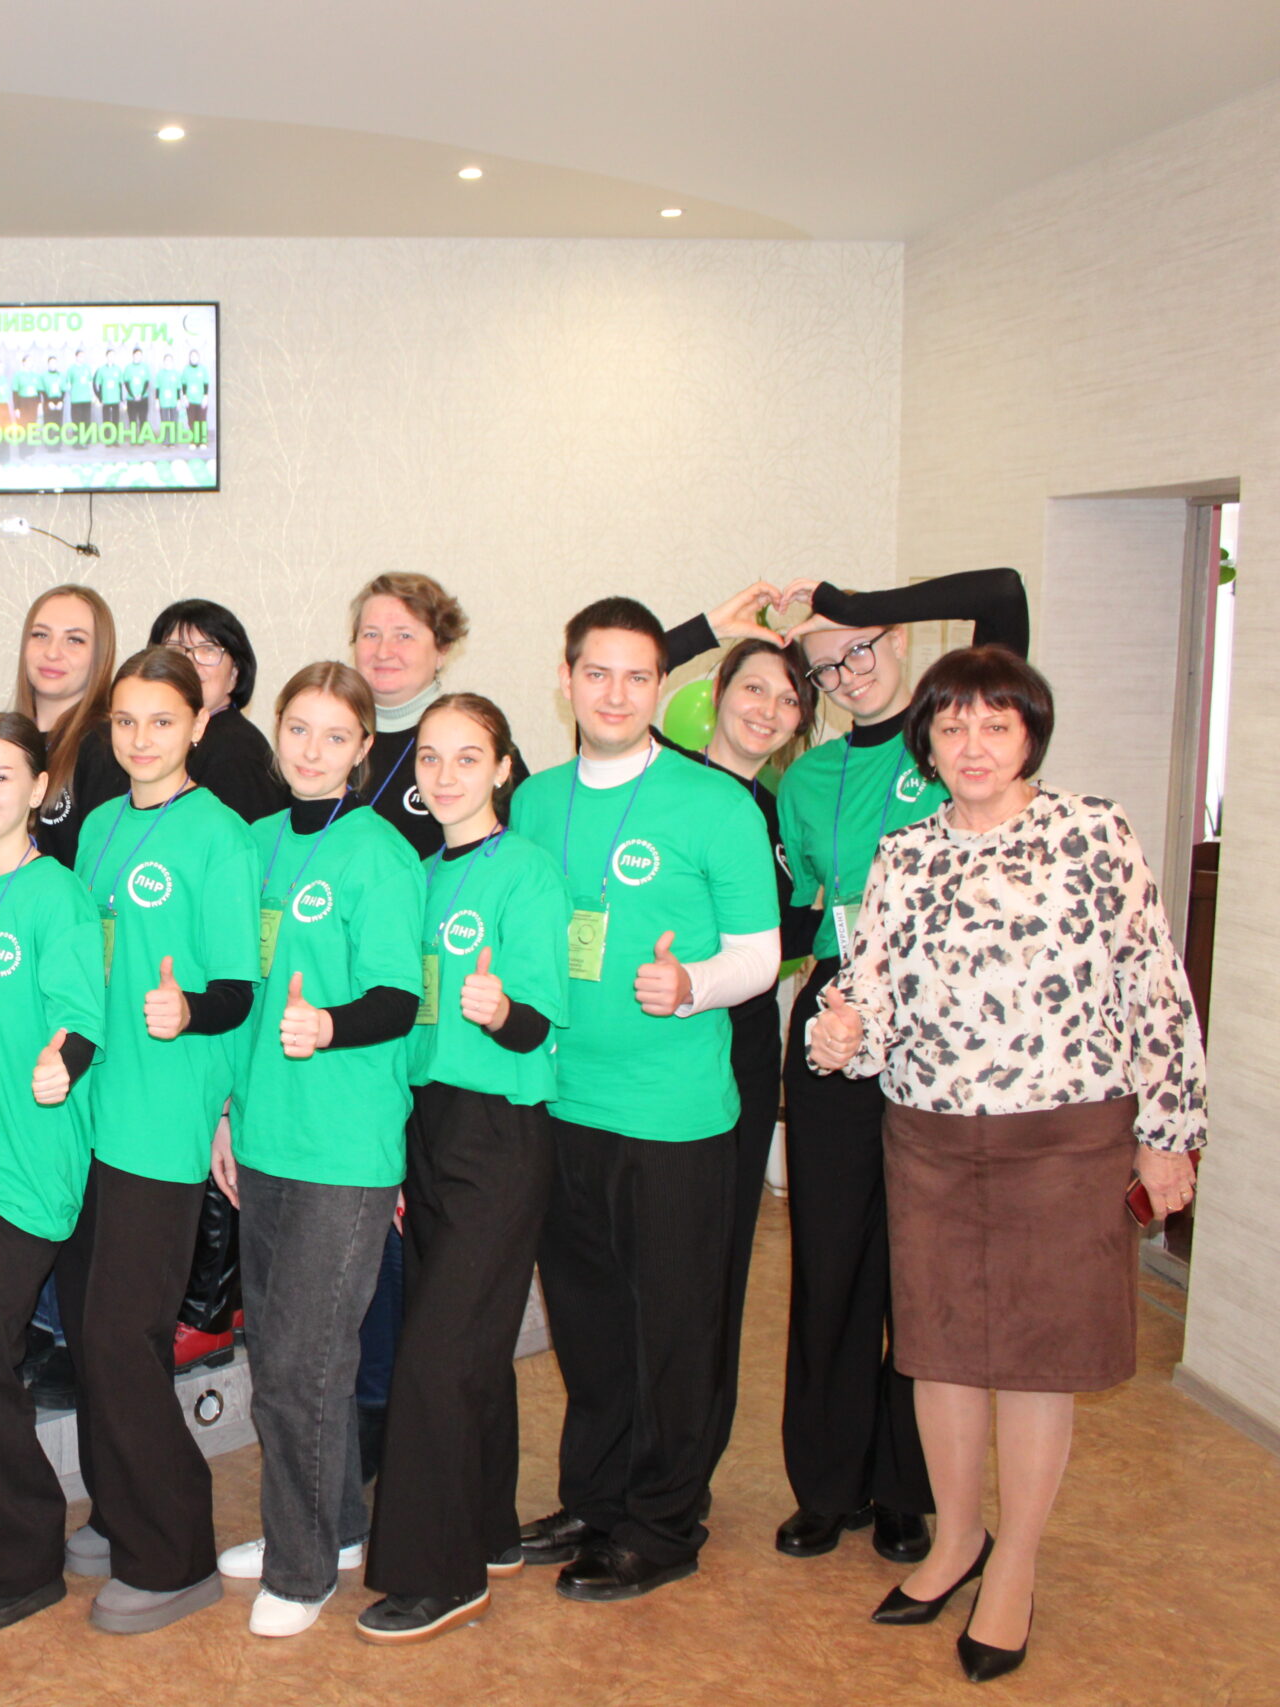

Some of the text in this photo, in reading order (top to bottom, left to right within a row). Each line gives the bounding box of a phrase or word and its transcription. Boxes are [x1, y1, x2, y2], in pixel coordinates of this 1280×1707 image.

[102, 323, 173, 345] ПУТИ,
[620, 854, 652, 869] ЛНР
[134, 874, 165, 893] ЛНР
[301, 894, 326, 908] ЛНР
[450, 923, 477, 939] ЛНР
[835, 911, 846, 953] КУРСАНТ
